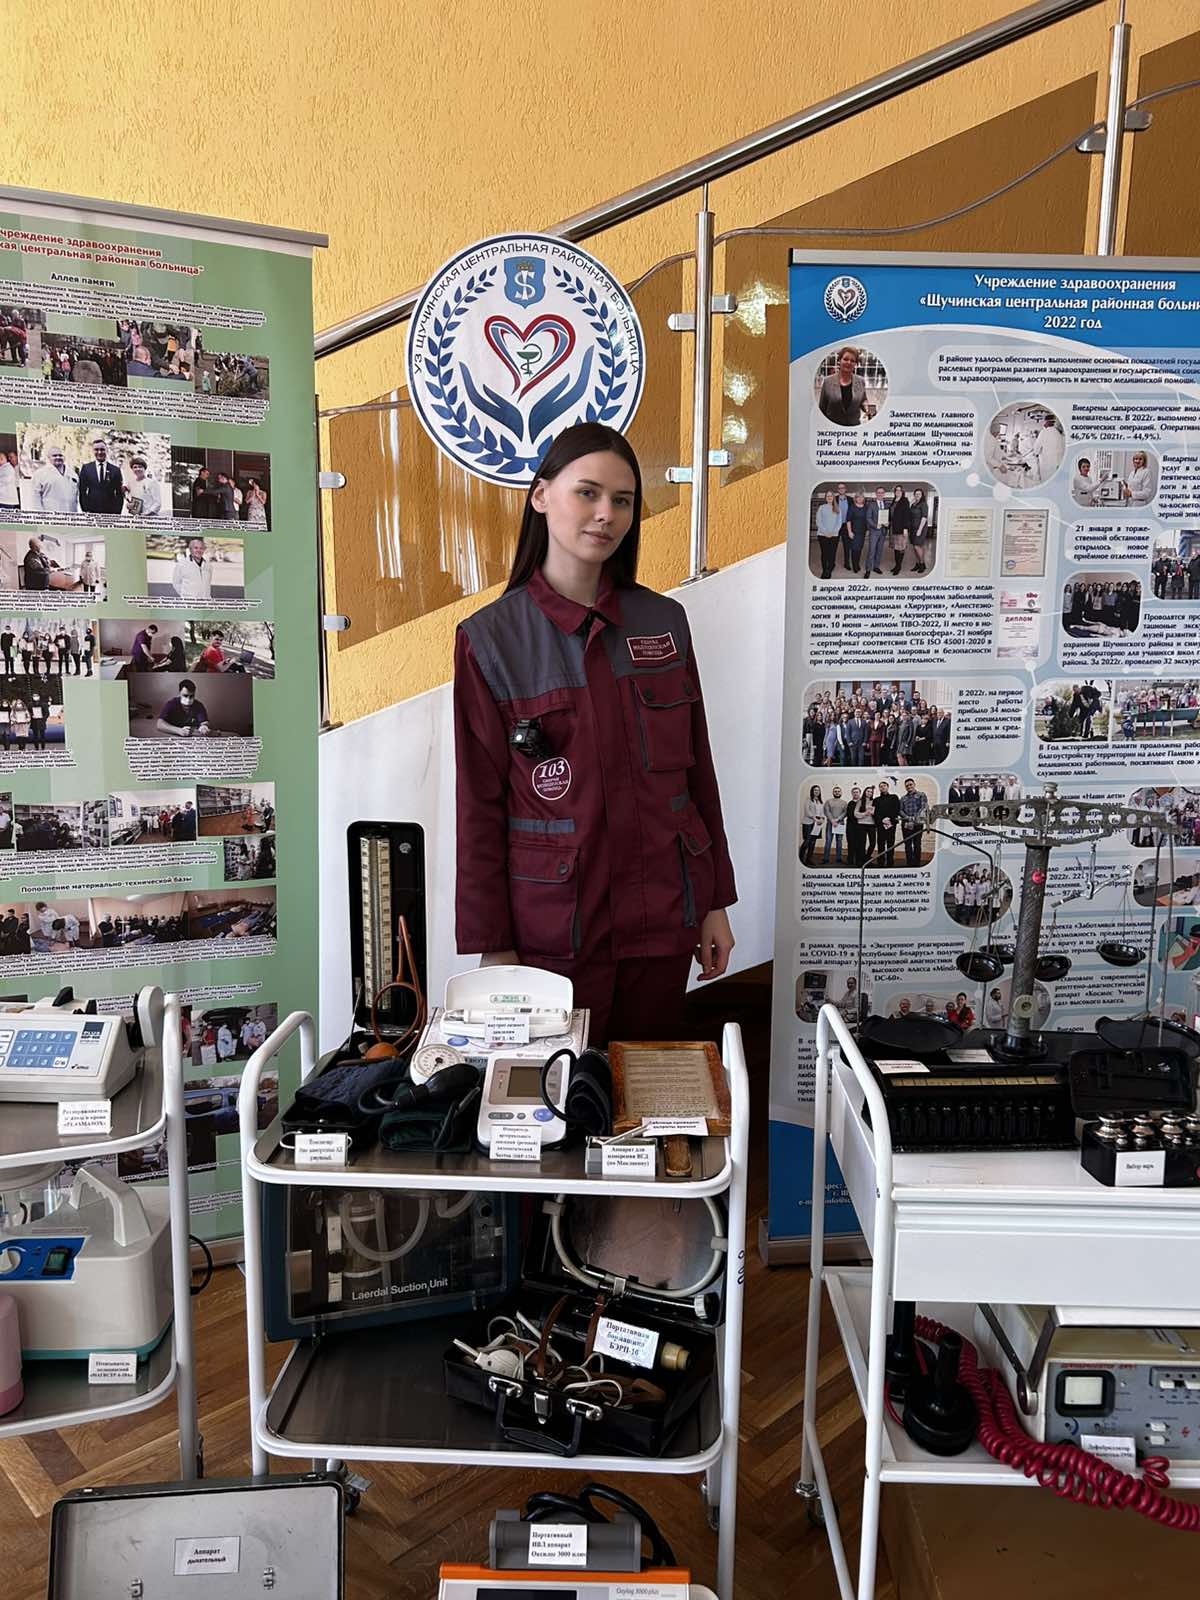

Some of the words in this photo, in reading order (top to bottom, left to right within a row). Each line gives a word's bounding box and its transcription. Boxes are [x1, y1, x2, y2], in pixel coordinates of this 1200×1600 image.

[66, 238, 162, 258] здравоохранения
[21, 244, 92, 261] центральная
[95, 252, 146, 268] районная
[51, 272, 79, 284] Аллея
[82, 276, 115, 288] памяти
[974, 274, 1057, 291] Учреждение
[1060, 279, 1176, 293] здравоохранения
[414, 354, 422, 374] УЗ
[418, 268, 460, 350] ЩУЧИНСКАЯ
[462, 242, 549, 276] ЦЕНТРАЛЬНАЯ
[551, 247, 613, 292] РАЙОННАЯ
[920, 293, 1001, 310] «Щучинская
[1005, 297, 1088, 312] центральная
[1092, 298, 1154, 312] районная
[1044, 316, 1076, 328] 2022
[1080, 320, 1102, 329] год
[946, 355, 974, 364] районе
[1114, 376, 1162, 385] медицинской
[1072, 404, 1108, 413] Внедрены
[62, 415, 87, 426] Наши
[90, 417, 115, 428] люди
[924, 420, 973, 429] медицинской
[874, 430, 926, 438] реабилитации
[931, 430, 973, 438] Щучинской
[816, 439, 832, 448] ЦРБ
[824, 656, 895, 666] профессиональной
[996, 697, 1023, 706] работы
[539, 760, 565, 778] 103
[21, 884, 70, 894] Пополнение
[71, 876, 171, 890] материально-технической
[352, 1286, 388, 1300] Laerdal
[390, 1282, 427, 1294] Suction
[429, 1278, 448, 1288] Unit
